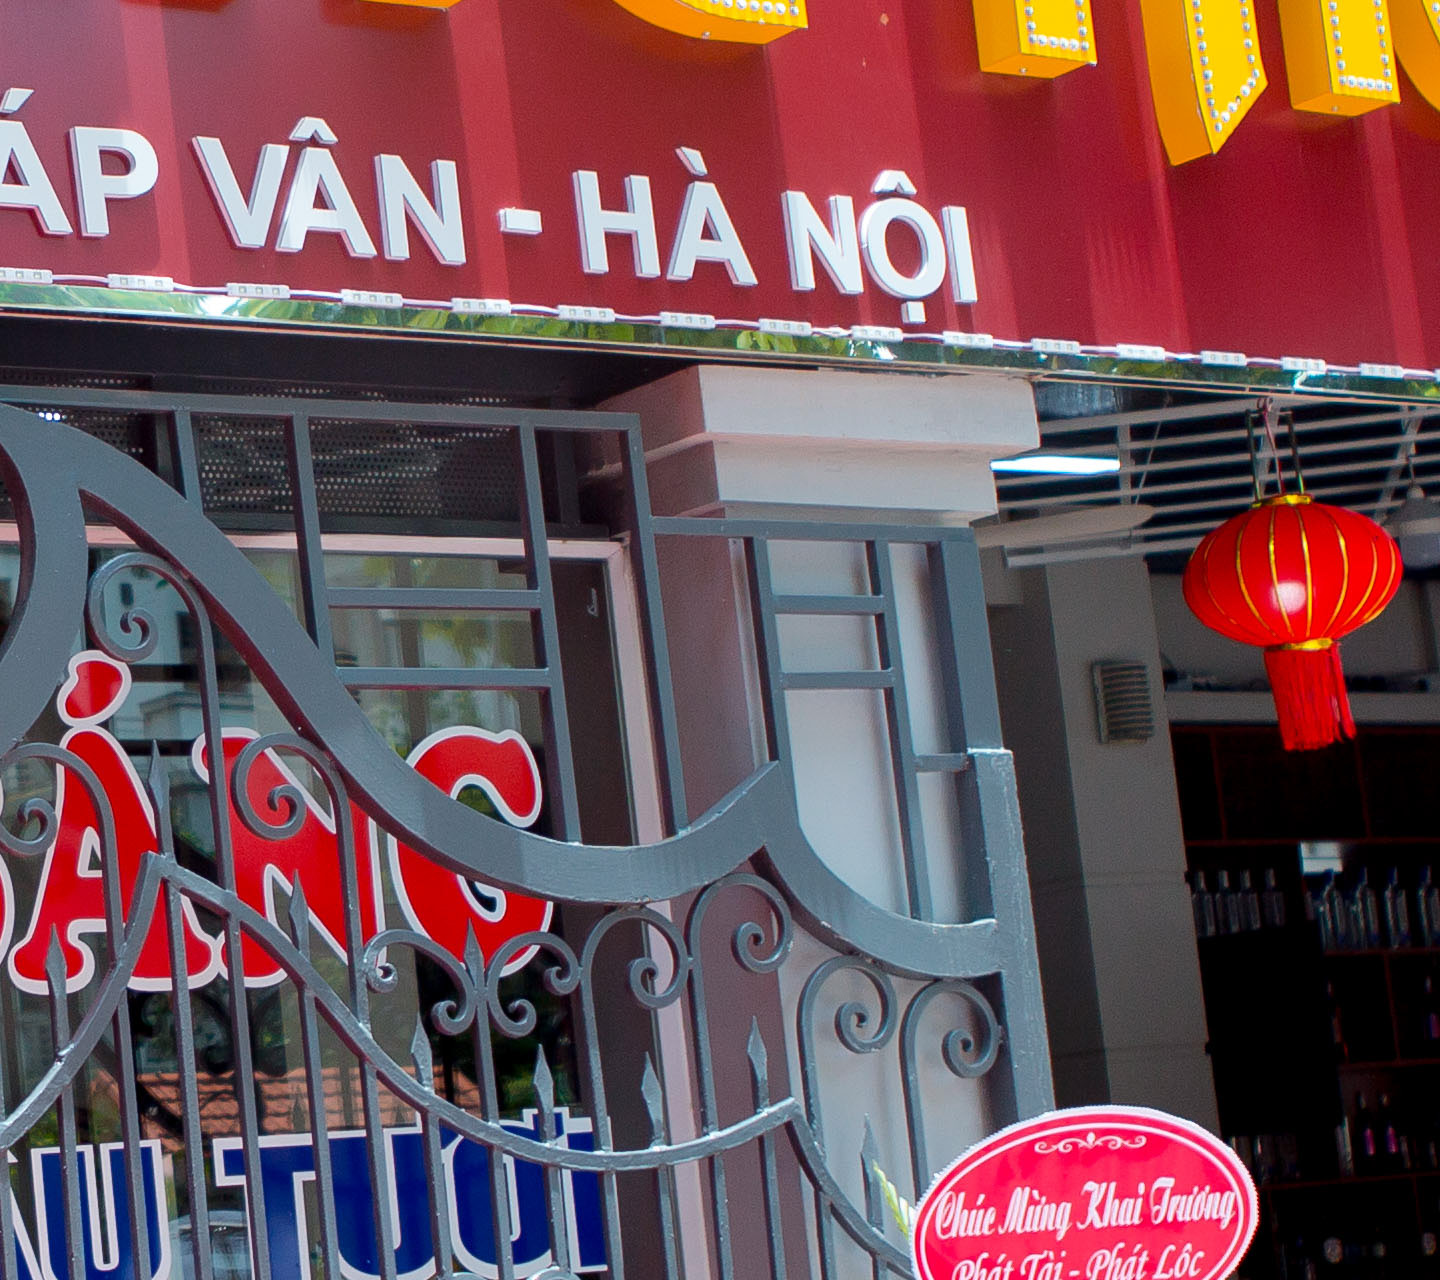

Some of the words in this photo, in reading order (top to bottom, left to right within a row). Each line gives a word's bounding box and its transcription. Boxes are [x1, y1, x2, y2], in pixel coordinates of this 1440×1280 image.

[192, 115, 467, 266] VÂN
[571, 146, 759, 287] HÀ
[780, 169, 978, 325] NỘI
[935, 1190, 997, 1240] Chúc
[1076, 1180, 1144, 1231] Khai
